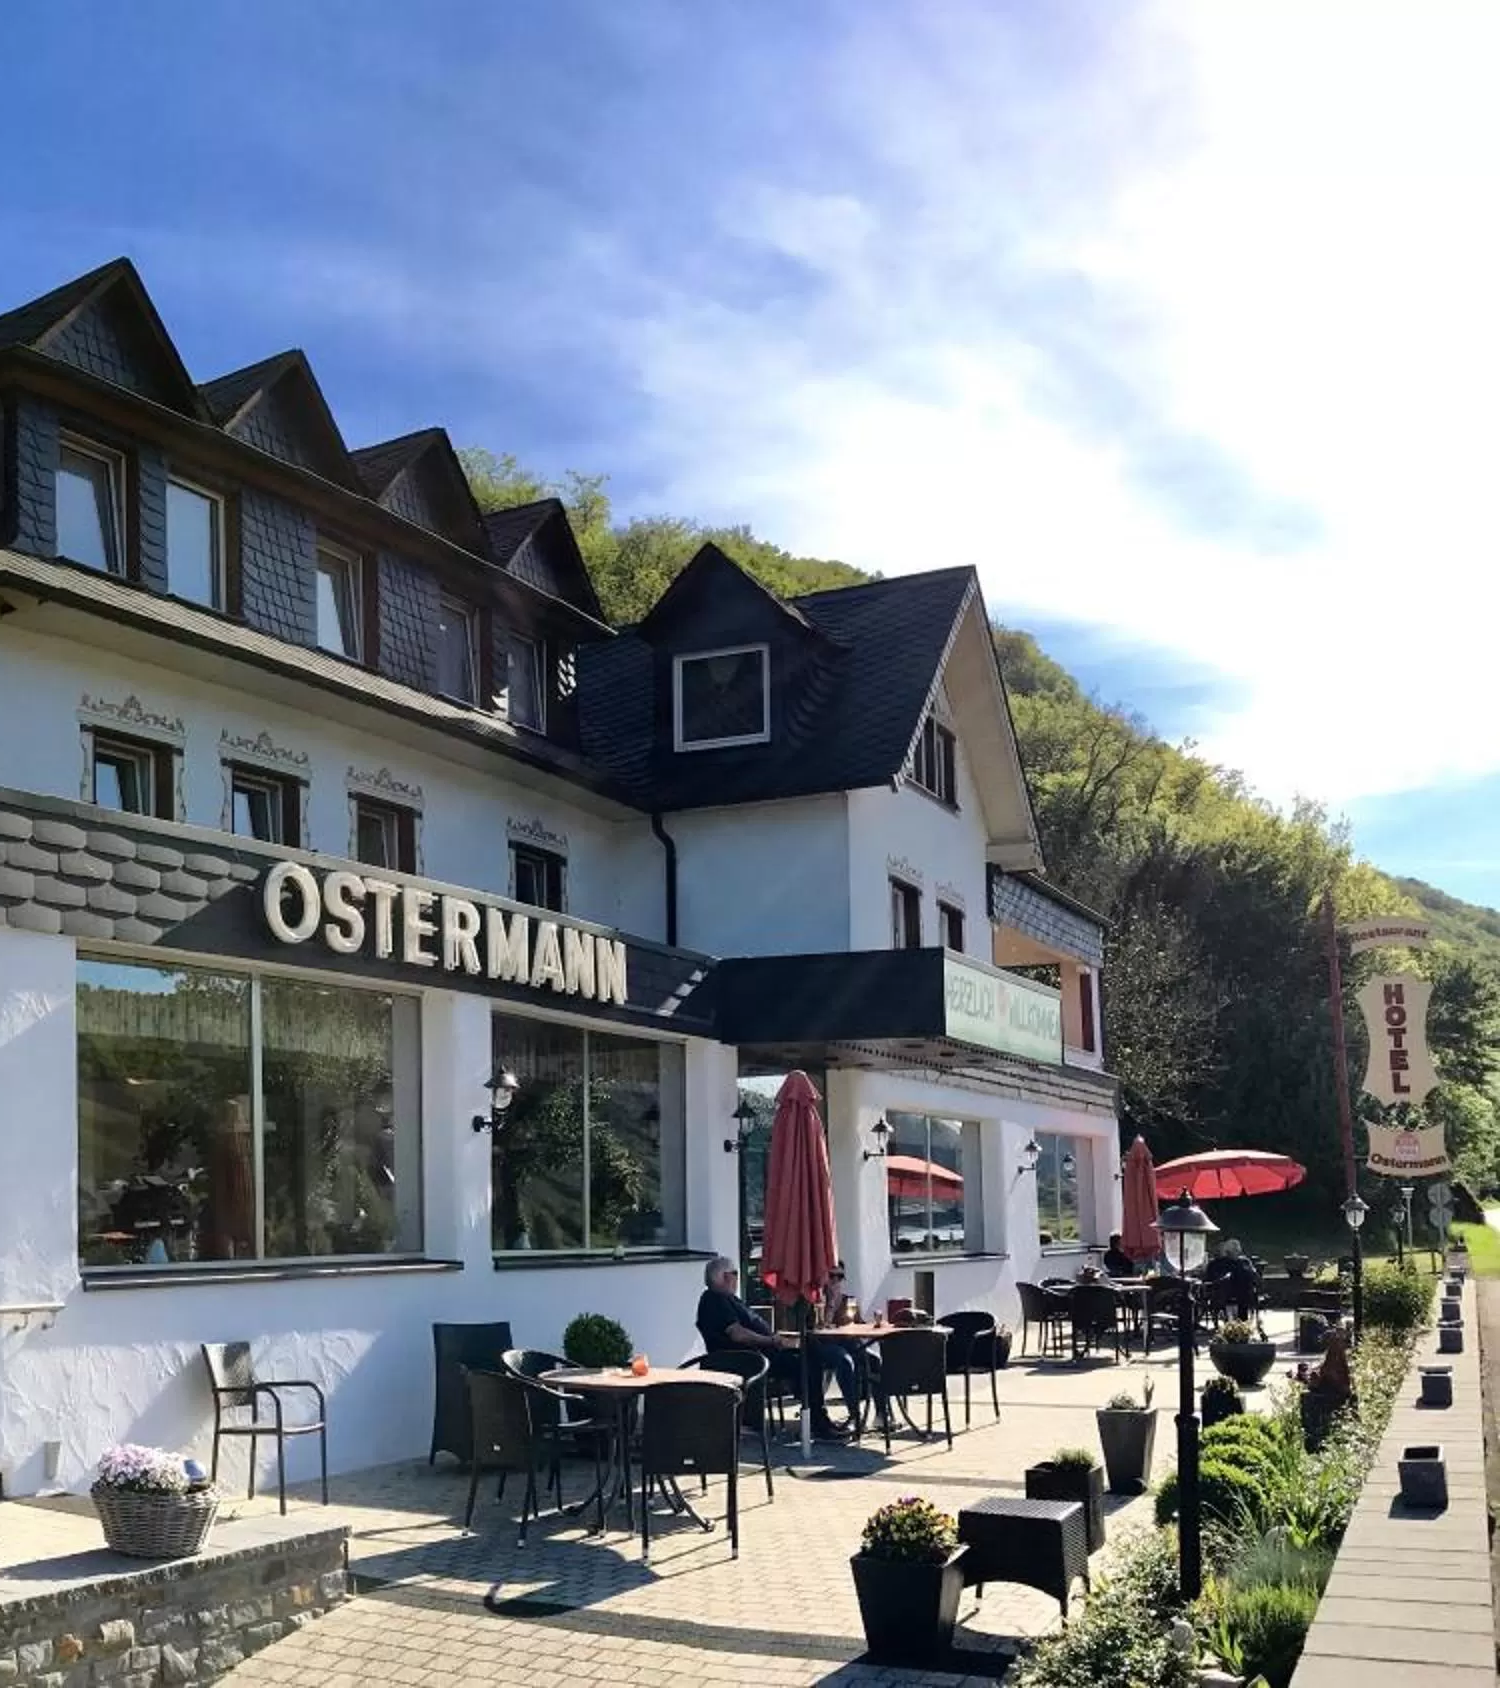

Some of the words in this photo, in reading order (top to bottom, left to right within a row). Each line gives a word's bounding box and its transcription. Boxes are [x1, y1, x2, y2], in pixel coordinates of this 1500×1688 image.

[264, 861, 629, 1005] OSTERMANN
[1383, 983, 1411, 1094] HOTEL
[1371, 1152, 1447, 1169] Ostermann
